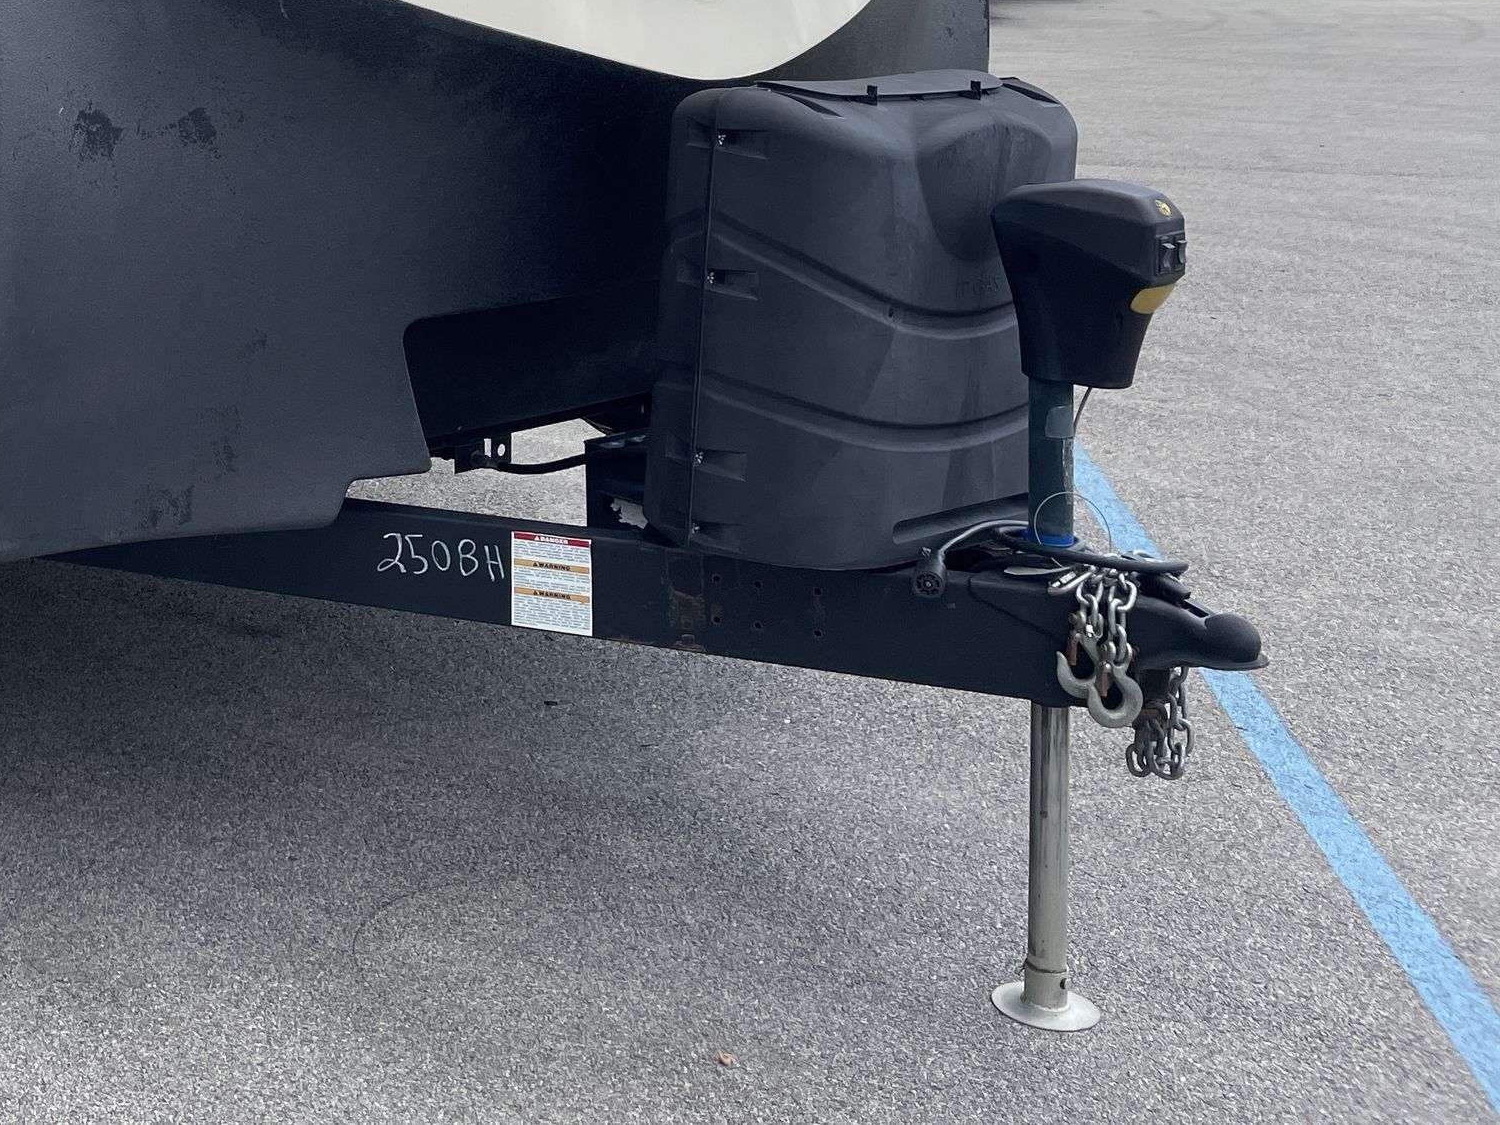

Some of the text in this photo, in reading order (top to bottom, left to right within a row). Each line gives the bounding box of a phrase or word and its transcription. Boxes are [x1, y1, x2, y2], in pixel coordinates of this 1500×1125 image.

[539, 535, 569, 545] DANGER
[376, 532, 506, 582] 250BH
[538, 562, 571, 572] WARNING
[538, 590, 571, 600] WARNING
